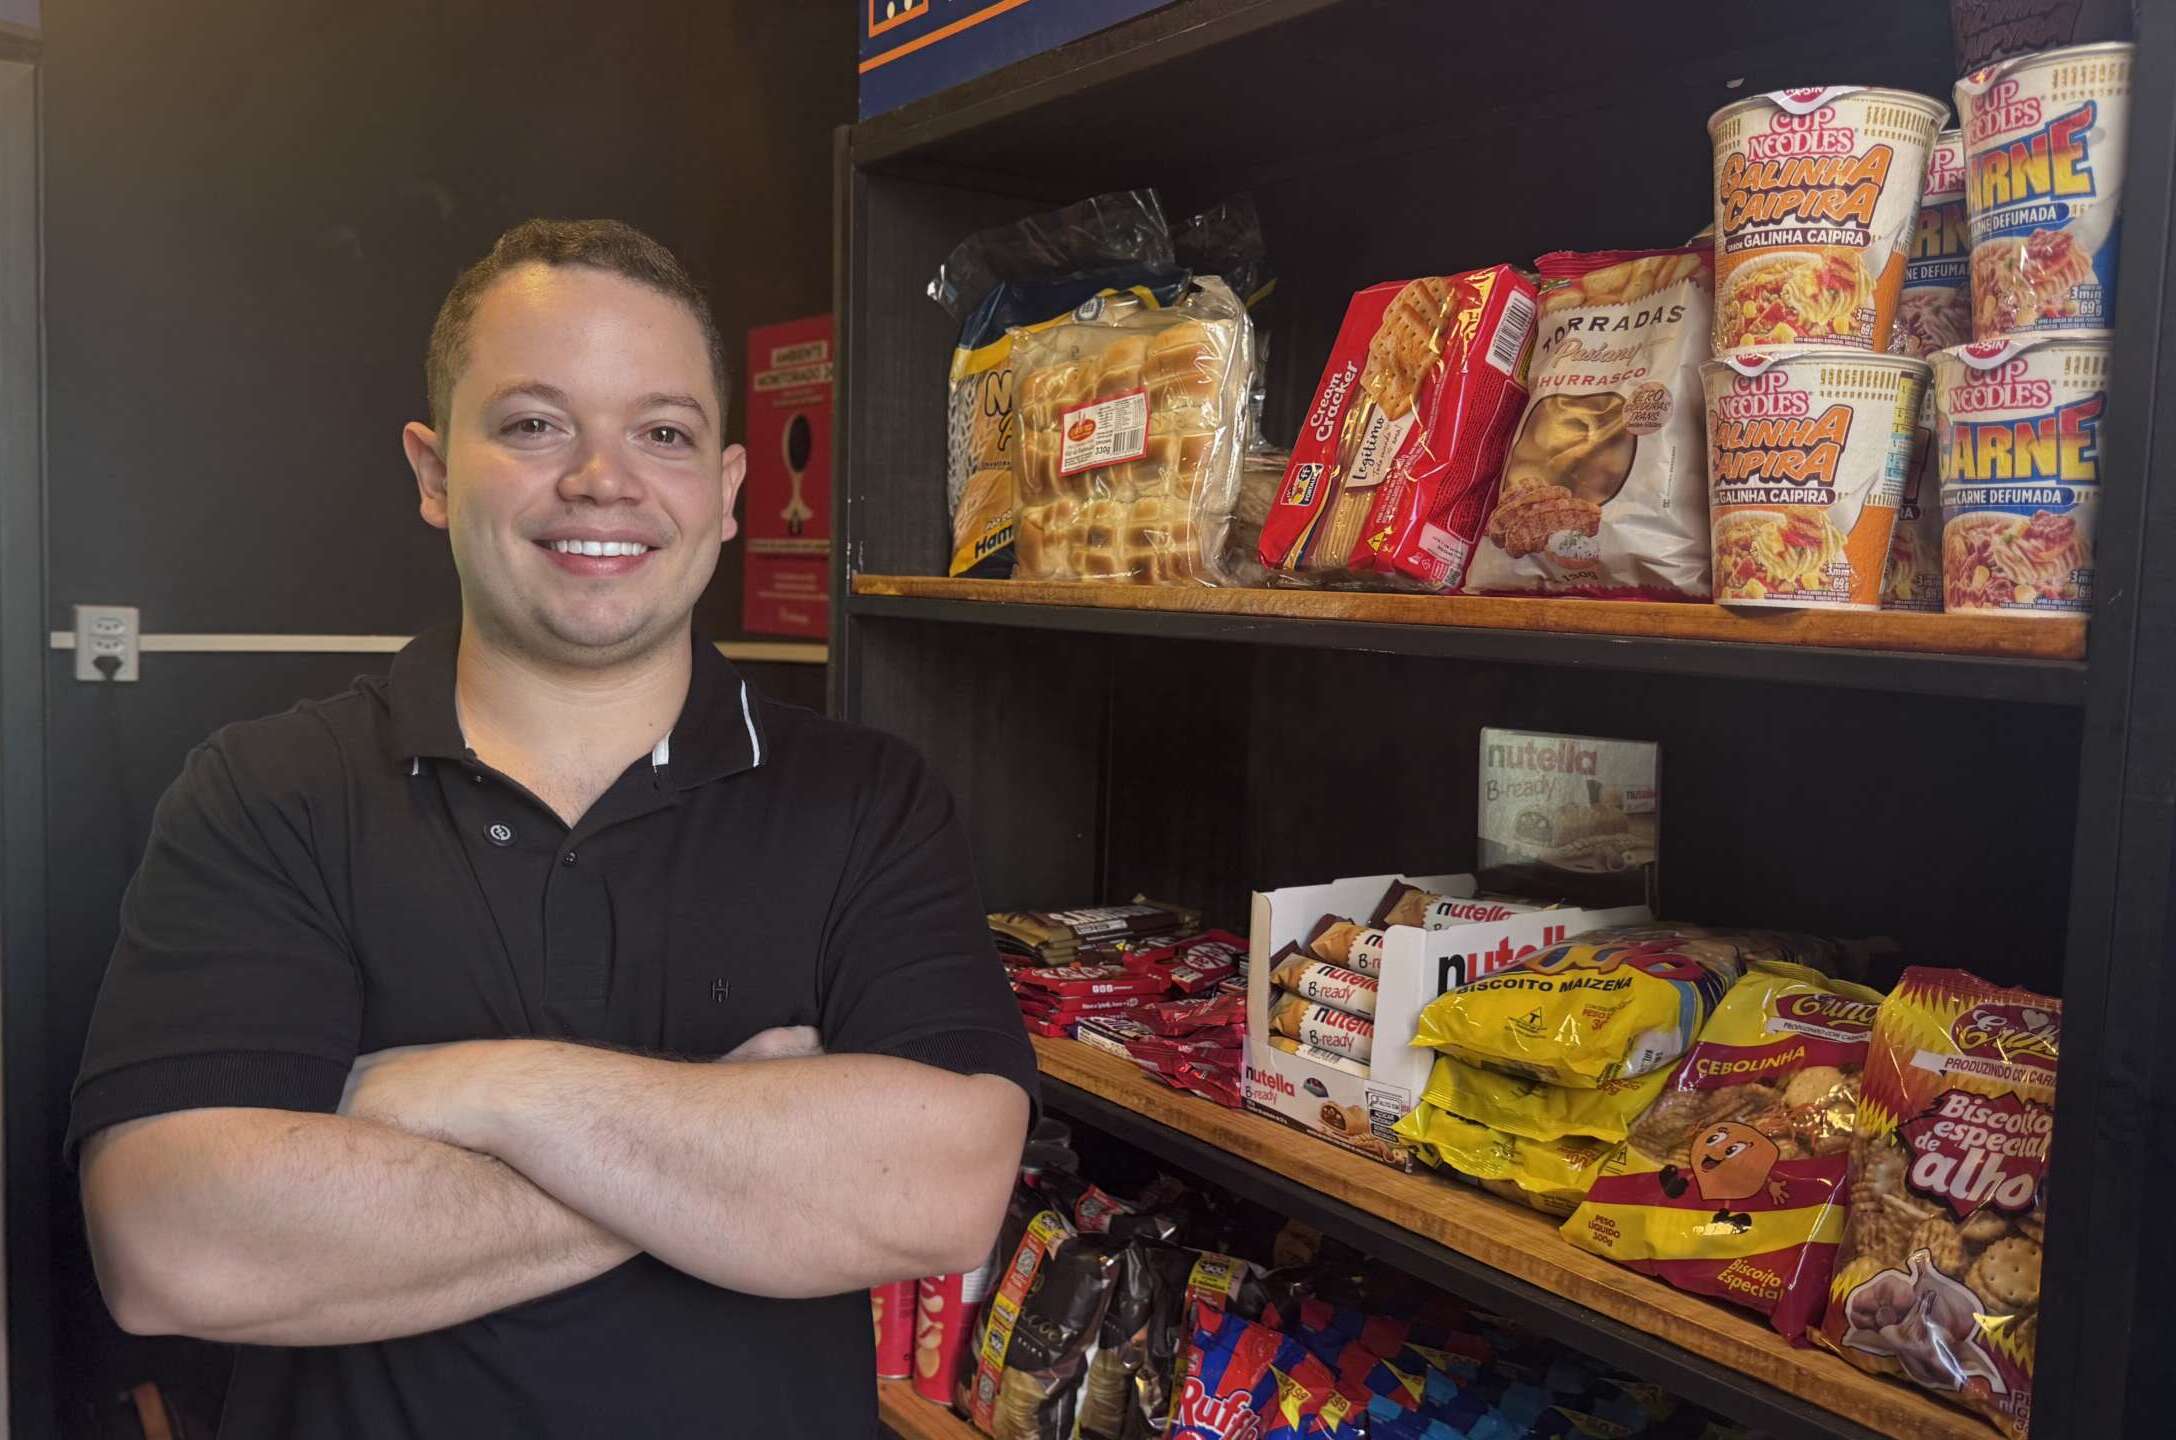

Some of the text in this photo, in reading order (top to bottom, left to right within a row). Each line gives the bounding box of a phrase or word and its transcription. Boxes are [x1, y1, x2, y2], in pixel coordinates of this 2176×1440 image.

[1972, 80, 2019, 113] CUP
[1772, 107, 1834, 133] CUP
[1750, 129, 1853, 160] NOODLES
[1722, 145, 1893, 196] GALINHA
[1724, 184, 1880, 231] CAIPIRA
[1993, 206, 2057, 229] DEFUMADA
[1744, 229, 1804, 248] GALINHA
[1807, 228, 1865, 246] CAIPIRA
[1542, 305, 1685, 353] TORRADAS
[1734, 371, 1788, 396] CUP
[1966, 359, 2027, 386] CUP
[1310, 372, 1342, 427] Cream
[1316, 360, 1358, 442] Cracker
[1719, 391, 1808, 419] NOODLES
[1951, 381, 2051, 412] NOODLES
[1719, 488, 1828, 504] GALINHA CAIPIRA
[1957, 488, 2062, 504] CARNE DEFUMADA
[1488, 739, 1597, 775] nutella
[1486, 776, 1557, 801] B-ready
[1308, 981, 1355, 1001] B-ready
[1559, 976, 1633, 993] MAIZENA
[1310, 1030, 1354, 1048] B-ready
[1696, 1045, 1806, 1075] CEBOLINHA
[1945, 1057, 2011, 1080] PRODUZINDO
[1246, 1066, 1296, 1097] nutella
[1940, 1095, 2053, 1135] Biscoito
[1914, 1131, 1941, 1151] de
[1934, 1121, 2050, 1157] especial
[1912, 1148, 2034, 1206] alho
[1595, 1214, 1616, 1228] PESO
[1592, 1232, 1613, 1247] 300g
[1717, 1270, 1784, 1301] Especial
[1728, 1258, 1782, 1287] Biscoito
